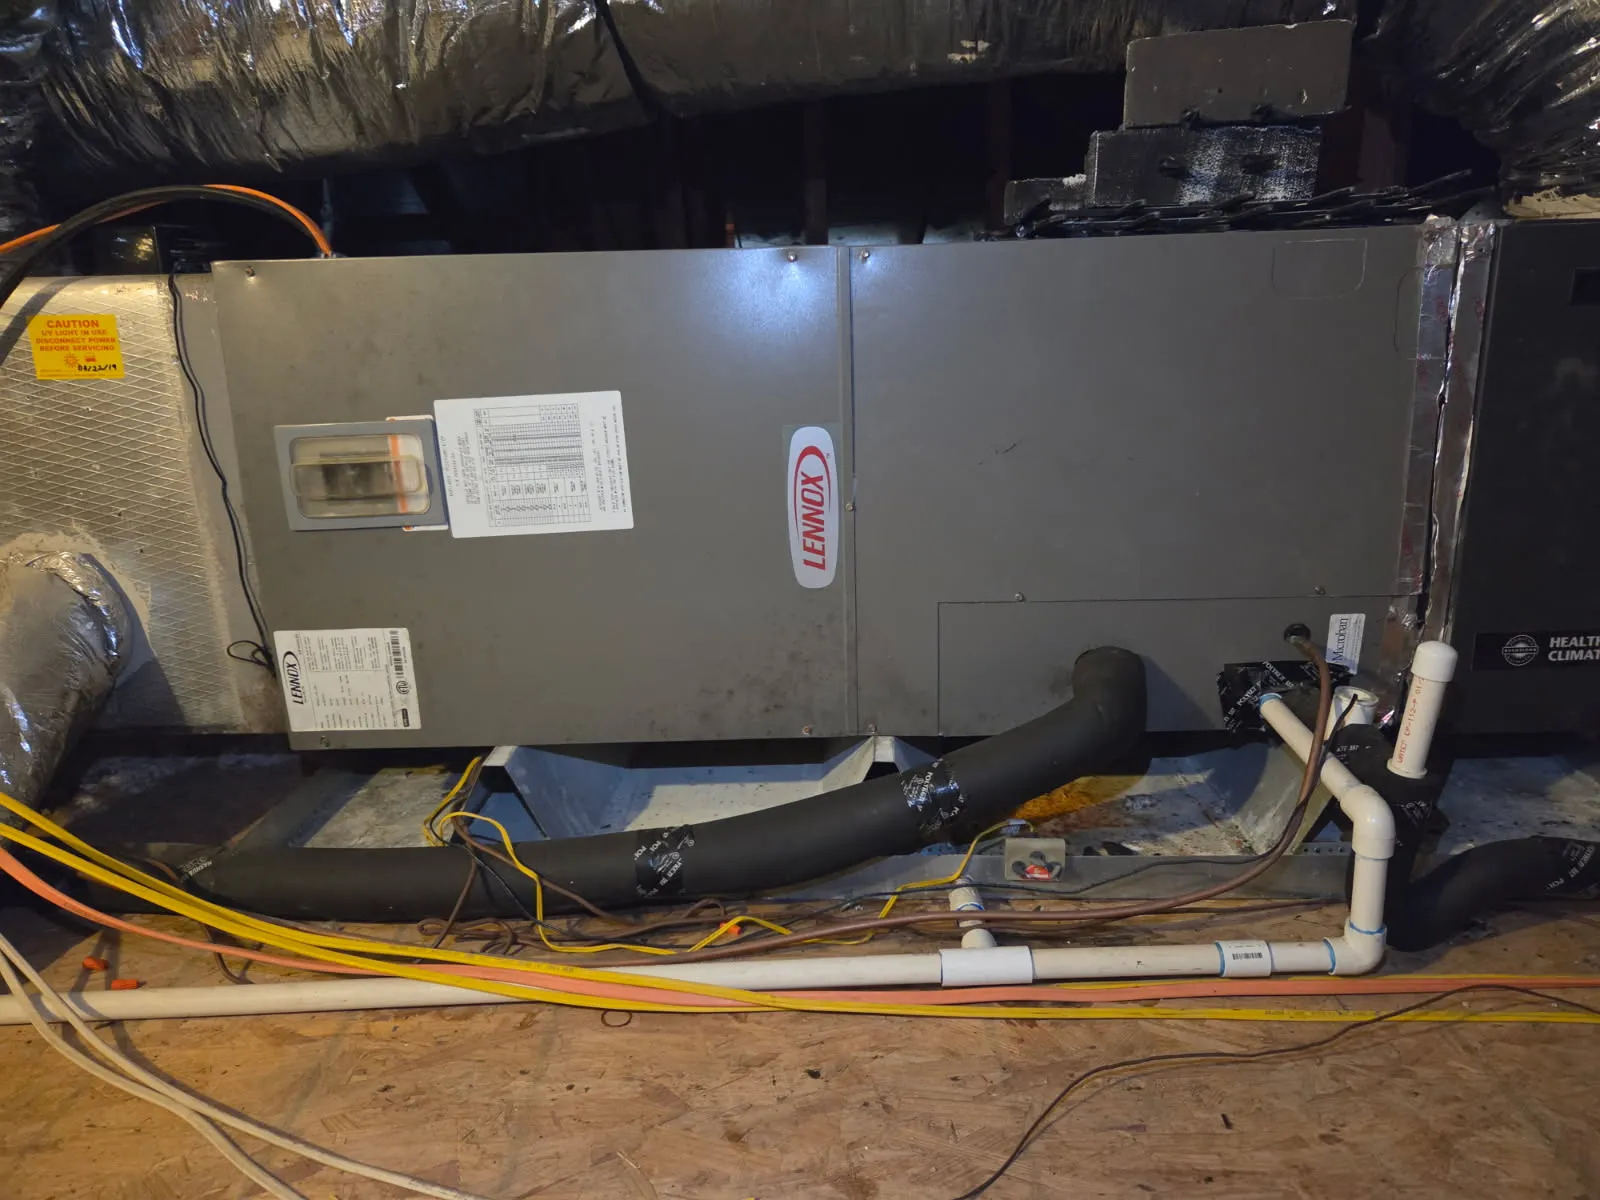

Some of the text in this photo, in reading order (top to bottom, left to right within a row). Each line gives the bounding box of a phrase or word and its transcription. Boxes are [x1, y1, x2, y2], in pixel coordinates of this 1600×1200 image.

[46, 319, 99, 329] CAUTION
[800, 471, 826, 571] LENNOX
[1332, 618, 1348, 661] Microban
[286, 662, 304, 705] LENNOX
